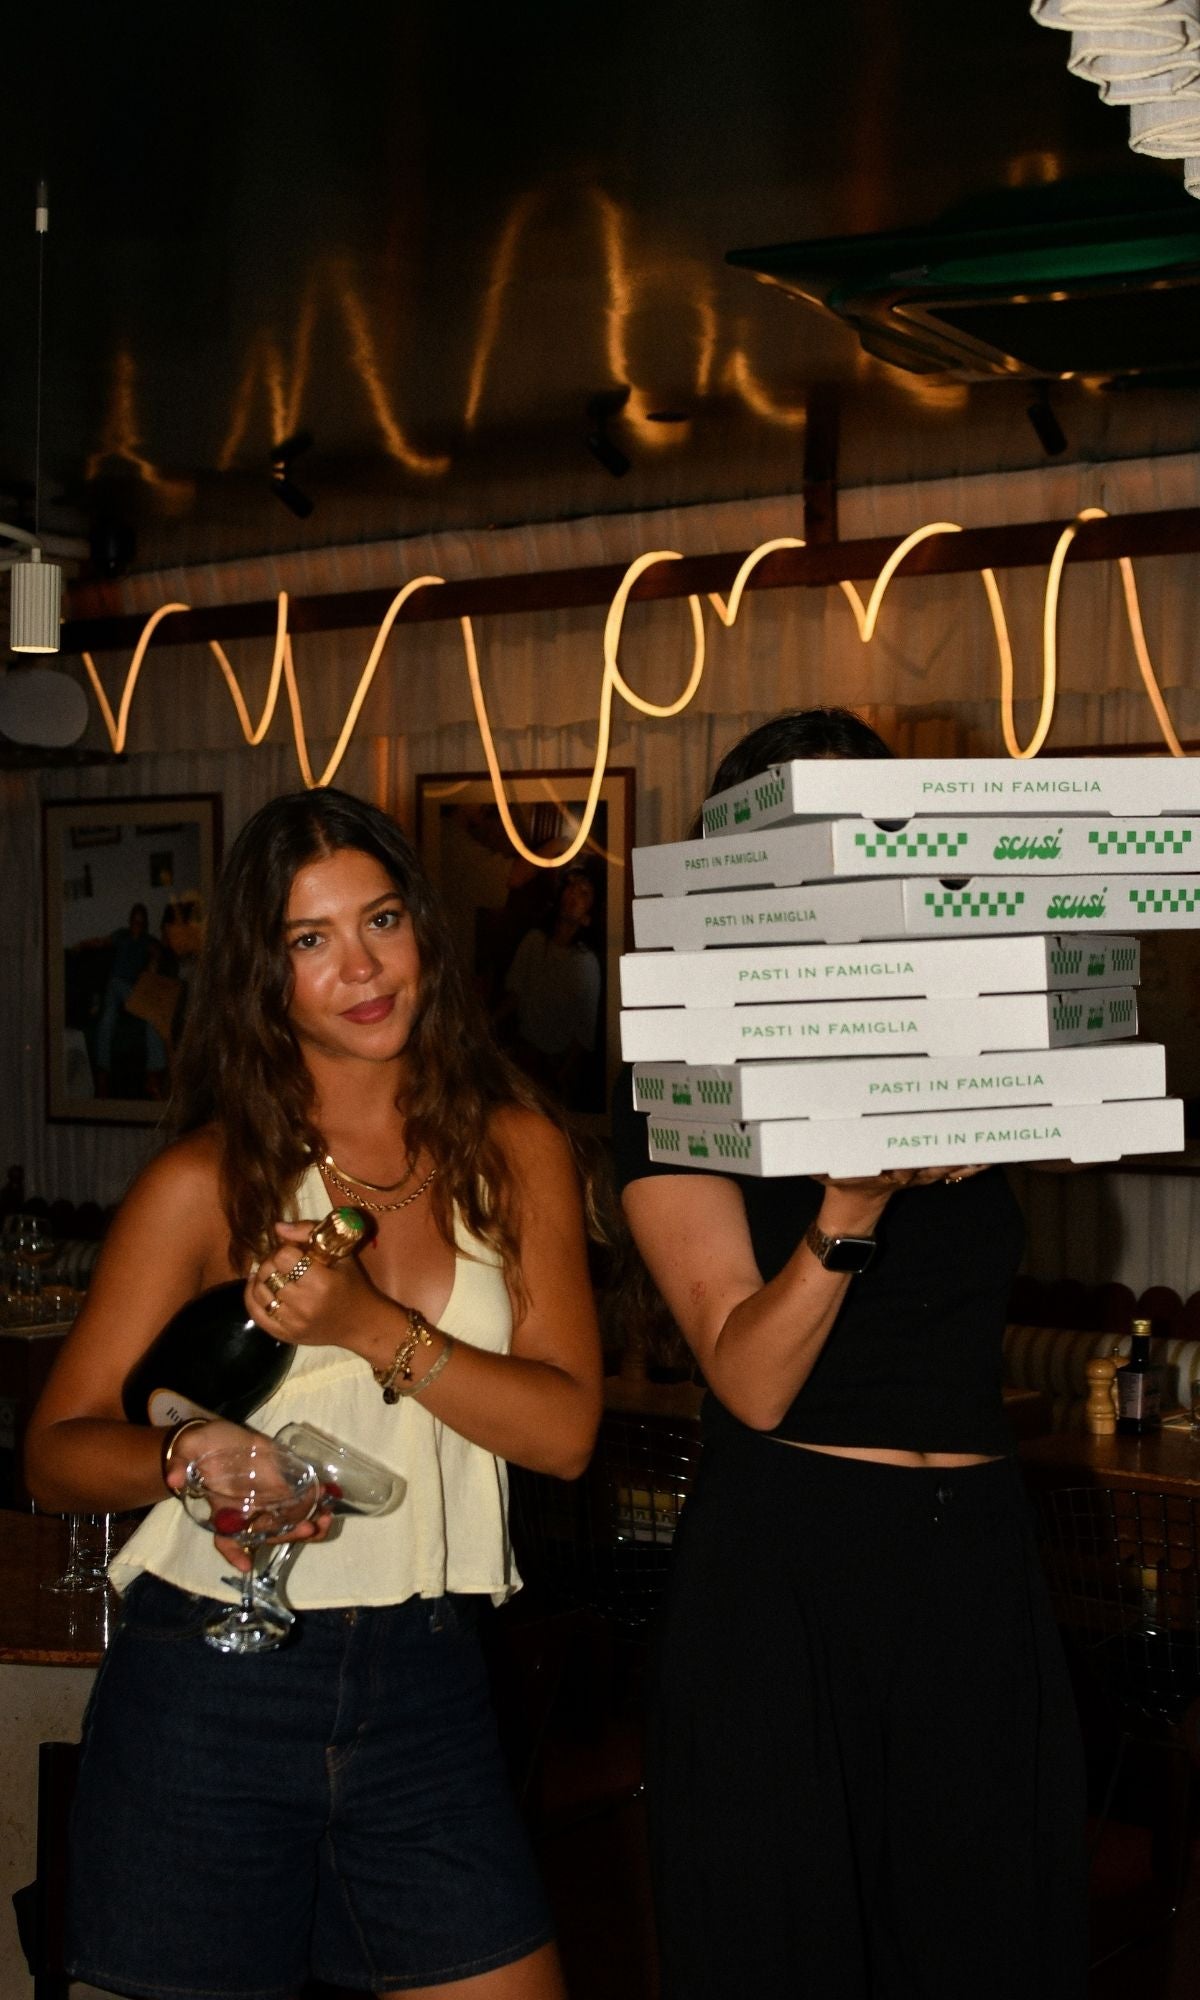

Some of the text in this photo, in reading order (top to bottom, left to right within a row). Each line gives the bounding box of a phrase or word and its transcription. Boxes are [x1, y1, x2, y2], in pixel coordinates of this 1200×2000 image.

[922, 781, 1103, 793] PASTI IN FAMIGLIA
[685, 850, 769, 871] PASTI IN FAMIGLIA
[704, 909, 817, 927] PASTI IN FAMIGLIA
[738, 962, 915, 981] PASTI IN FAMIGLIA
[741, 1021, 918, 1037] PASTI IN FAMIGLIA
[869, 1074, 1045, 1094] PASTI IN FAMIGLIA
[887, 1127, 1063, 1148] PASTI IN FAMIGLIA
